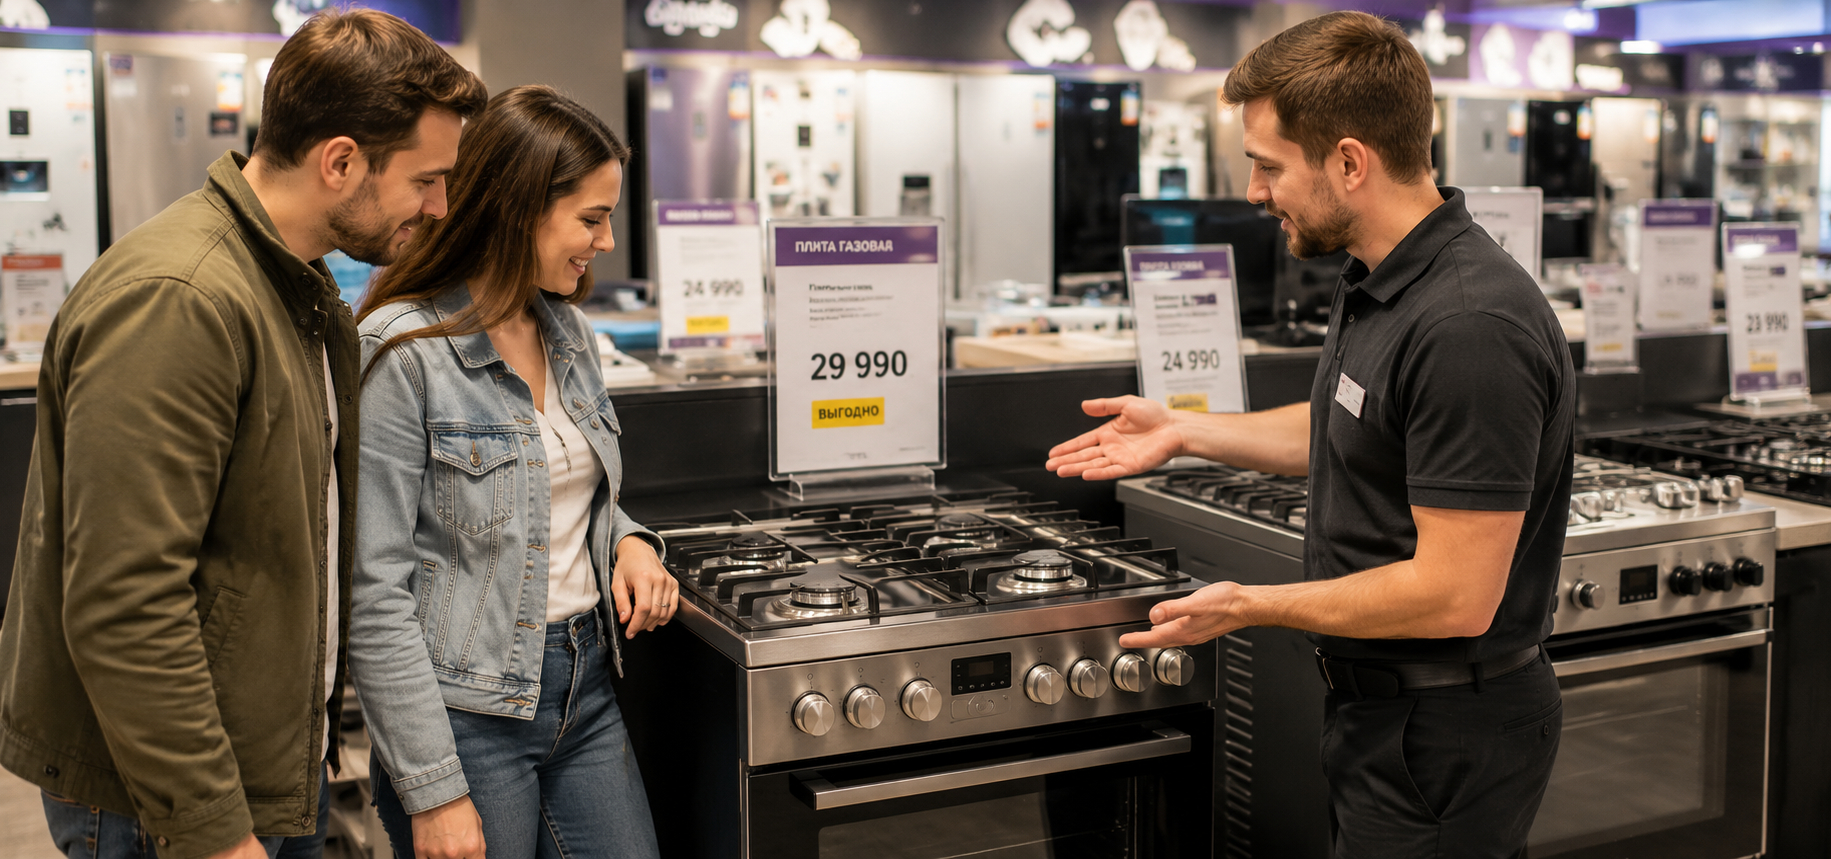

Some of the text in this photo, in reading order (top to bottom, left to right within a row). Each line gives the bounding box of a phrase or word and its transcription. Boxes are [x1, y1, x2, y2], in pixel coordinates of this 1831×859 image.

[683, 279, 744, 297] 24 990
[811, 350, 908, 381] 29 990
[1162, 350, 1220, 371] 24 990
[818, 405, 880, 420] ВЫГОДНО
